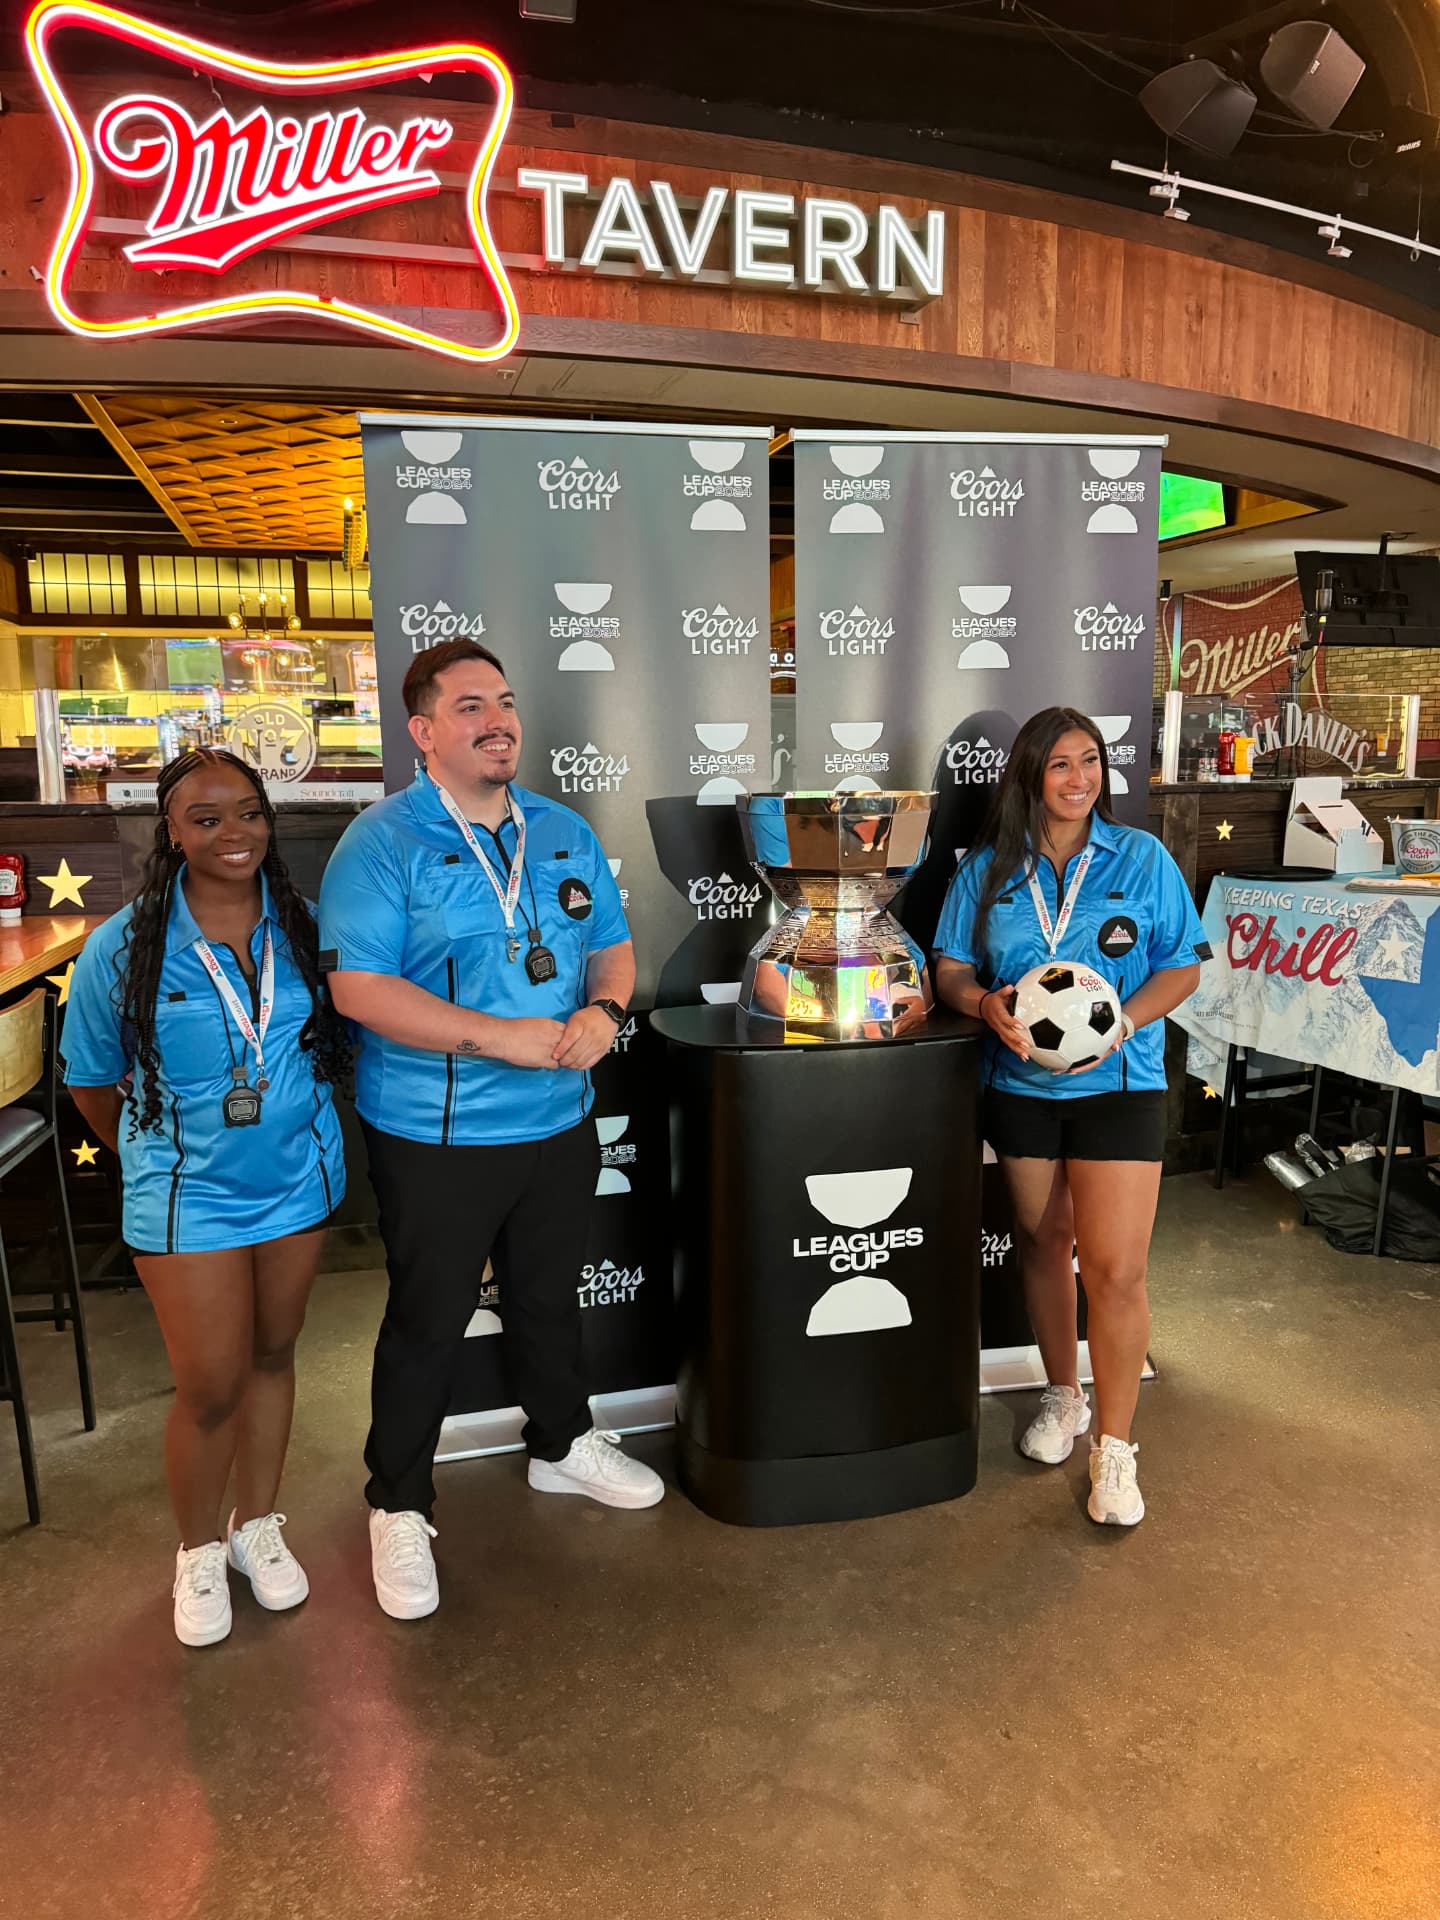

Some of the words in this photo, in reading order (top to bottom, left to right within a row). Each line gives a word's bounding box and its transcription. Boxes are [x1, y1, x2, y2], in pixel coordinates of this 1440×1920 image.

[98, 93, 454, 238] Miller
[517, 166, 946, 298] TAVERN
[396, 465, 472, 480] LEAGUES
[537, 459, 622, 493] Coors
[683, 474, 752, 487] LEAGUES
[396, 478, 431, 490] CUP
[682, 486, 715, 498] CUP
[823, 479, 891, 490] LEAGUES
[950, 469, 1025, 500] Coors
[1082, 481, 1146, 492] LEAGUES
[548, 492, 613, 511] LIGHT
[823, 490, 854, 501] CUP
[1081, 491, 1110, 502] CUP
[958, 501, 1017, 517] LIGHT
[399, 604, 486, 636] Coors
[550, 616, 620, 628] LEAGUES
[682, 607, 760, 639] Coors
[819, 609, 896, 640] Coors
[952, 617, 1017, 628] LEAGUES
[1073, 606, 1146, 636] Coors
[550, 626, 581, 638] CUP
[952, 627, 981, 638] CUP
[692, 639, 751, 655] LIGHT
[828, 640, 888, 656] LIGHT
[1080, 636, 1138, 651] LIGHT
[1179, 621, 1301, 695] Miller
[254, 712, 285, 725] OLD
[1284, 702, 1370, 773] DANIEL'S
[551, 746, 631, 778] Coors
[690, 754, 756, 766] LEAGUES
[825, 752, 889, 763] LEAGUES
[690, 765, 721, 775] CUP
[825, 762, 854, 774] CUP
[561, 777, 624, 793] LIGHT
[688, 877, 762, 905] Coors
[1224, 887, 1295, 910] KEEPING
[1300, 895, 1367, 921] TEXAS
[698, 904, 755, 921] LIGHT
[1226, 912, 1358, 986] Chill
[793, 1227, 924, 1258] LEAGUES
[830, 1250, 890, 1274] CUP
[579, 1286, 638, 1308] LIGHT
